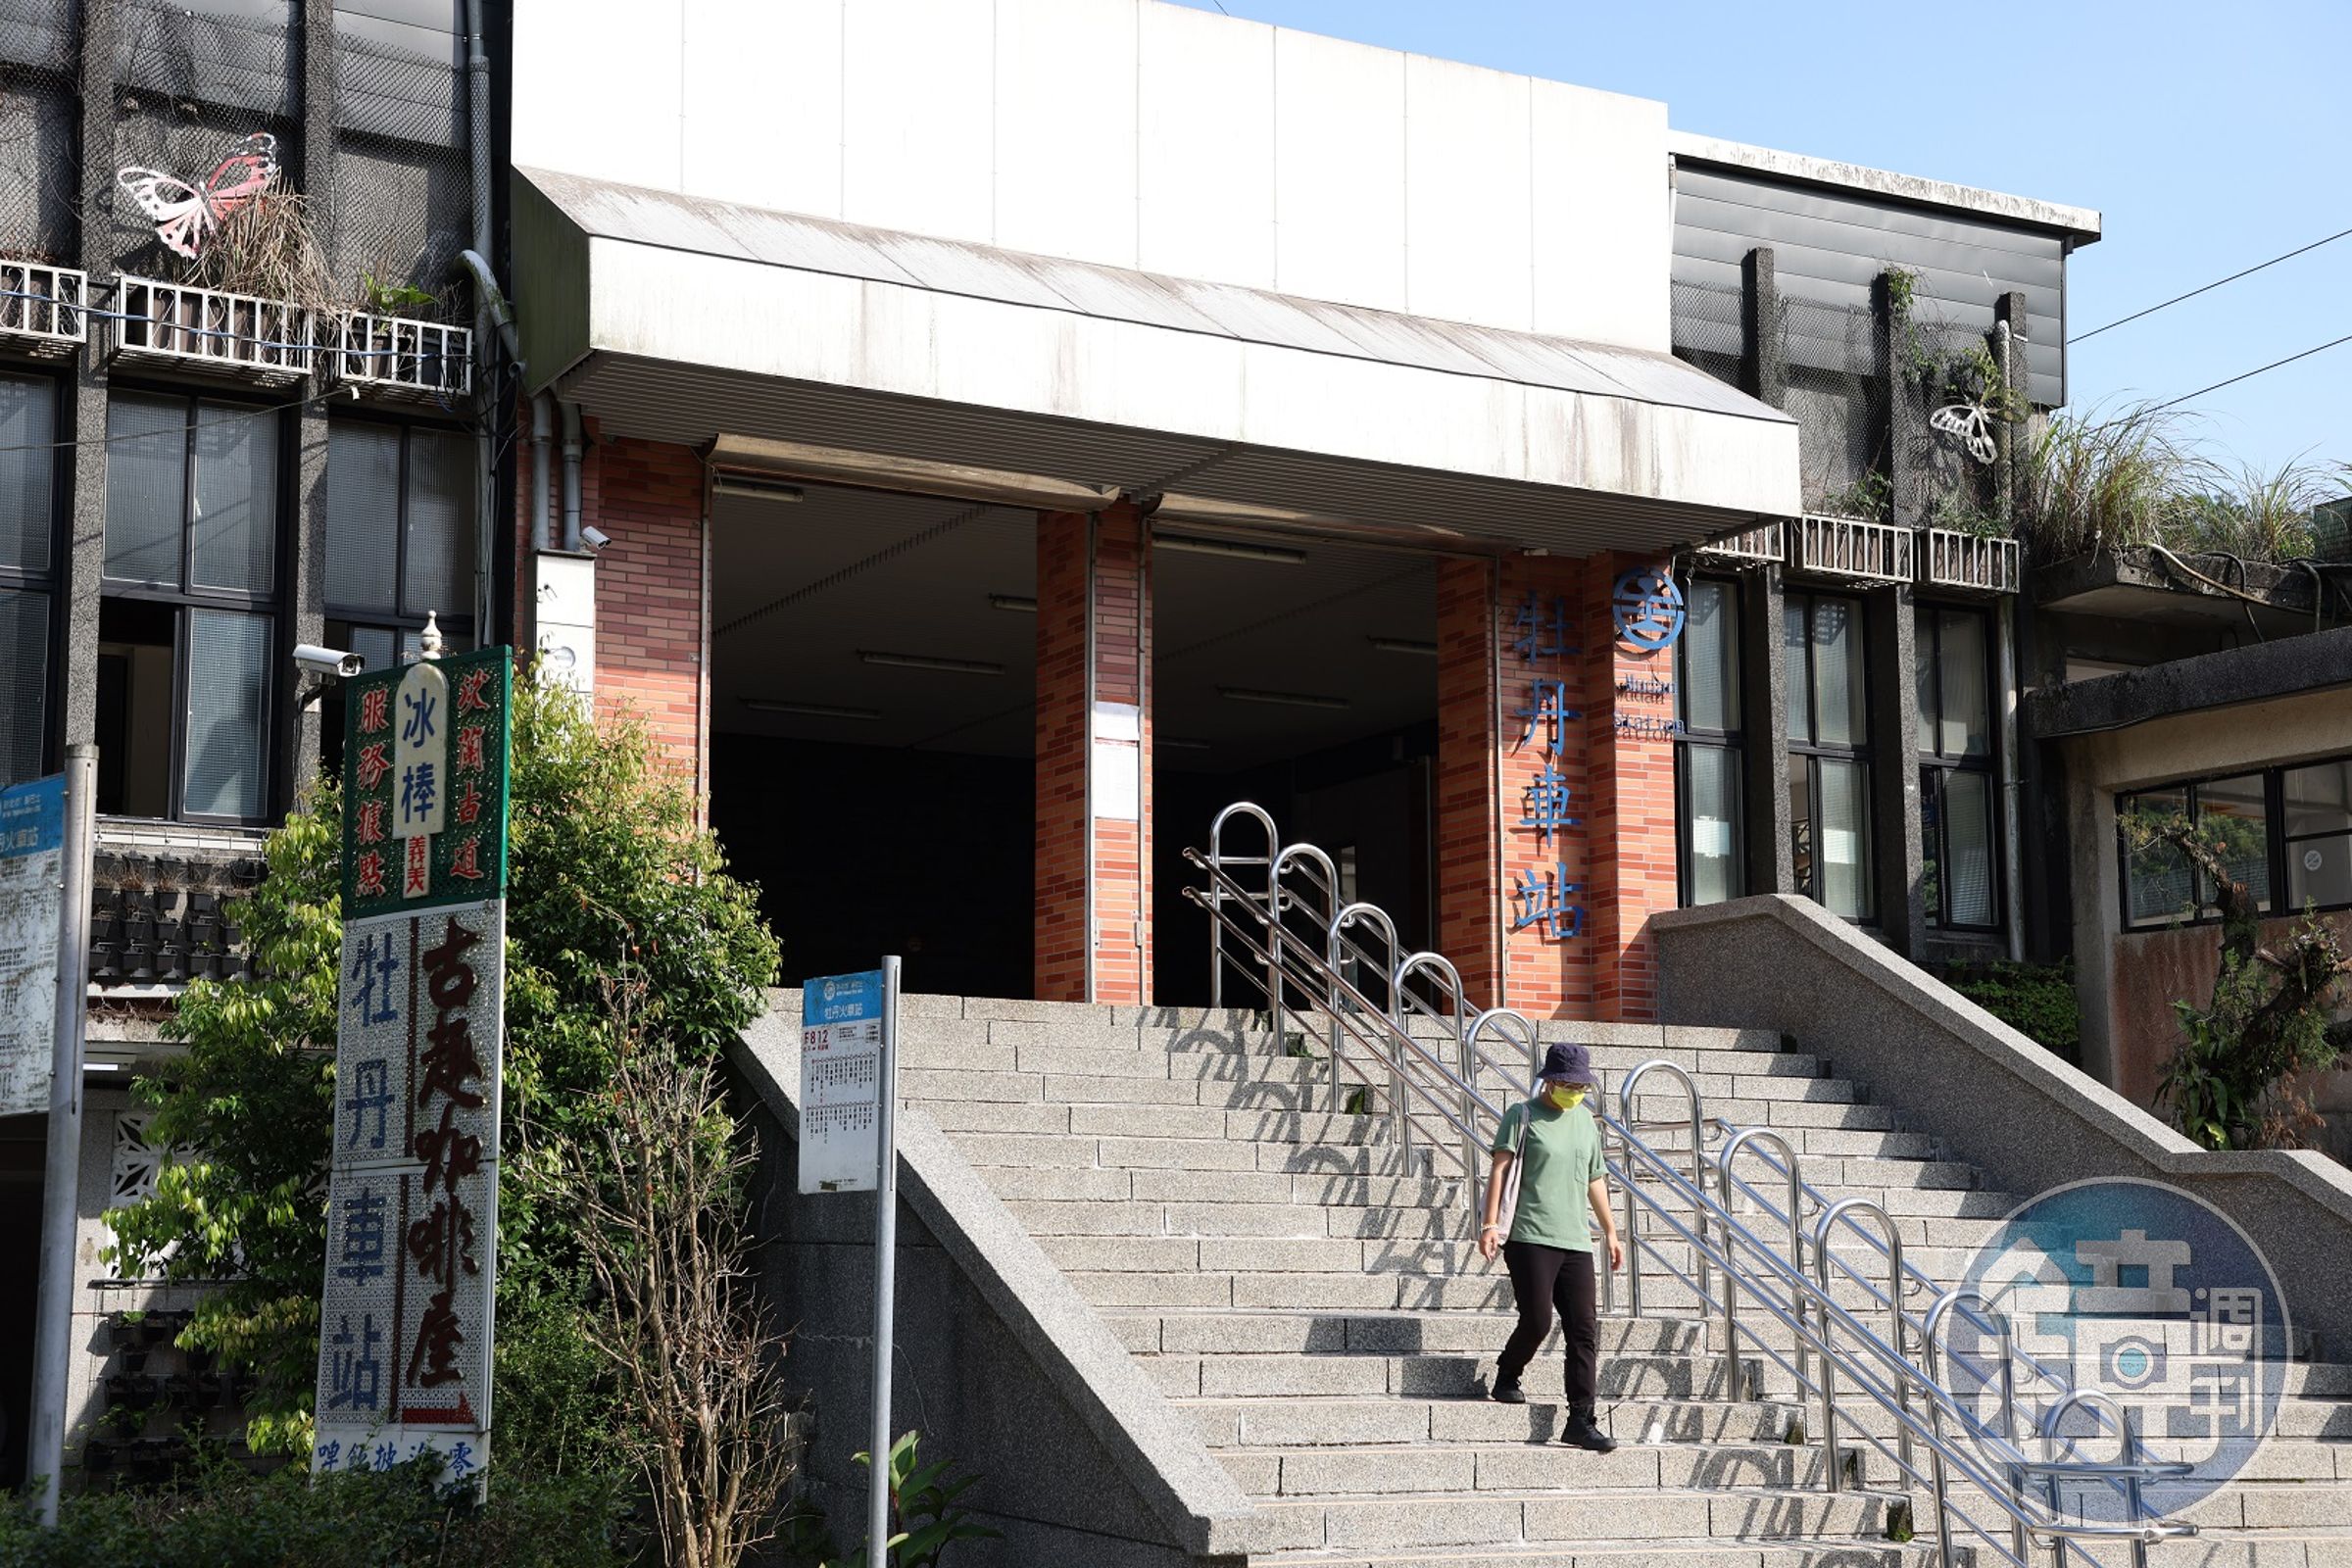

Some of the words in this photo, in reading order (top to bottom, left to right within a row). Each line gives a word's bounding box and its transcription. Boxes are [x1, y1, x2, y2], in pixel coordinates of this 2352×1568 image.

[355, 687, 390, 898] 服務據點
[401, 687, 437, 825] 冰棒
[451, 668, 490, 879] 淡蘭古道
[1514, 592, 1583, 938] 牡丹車站
[406, 835, 426, 895] 義美
[824, 1003, 863, 1019] 牡丹火車站
[331, 932, 398, 1410] 牡丹車站
